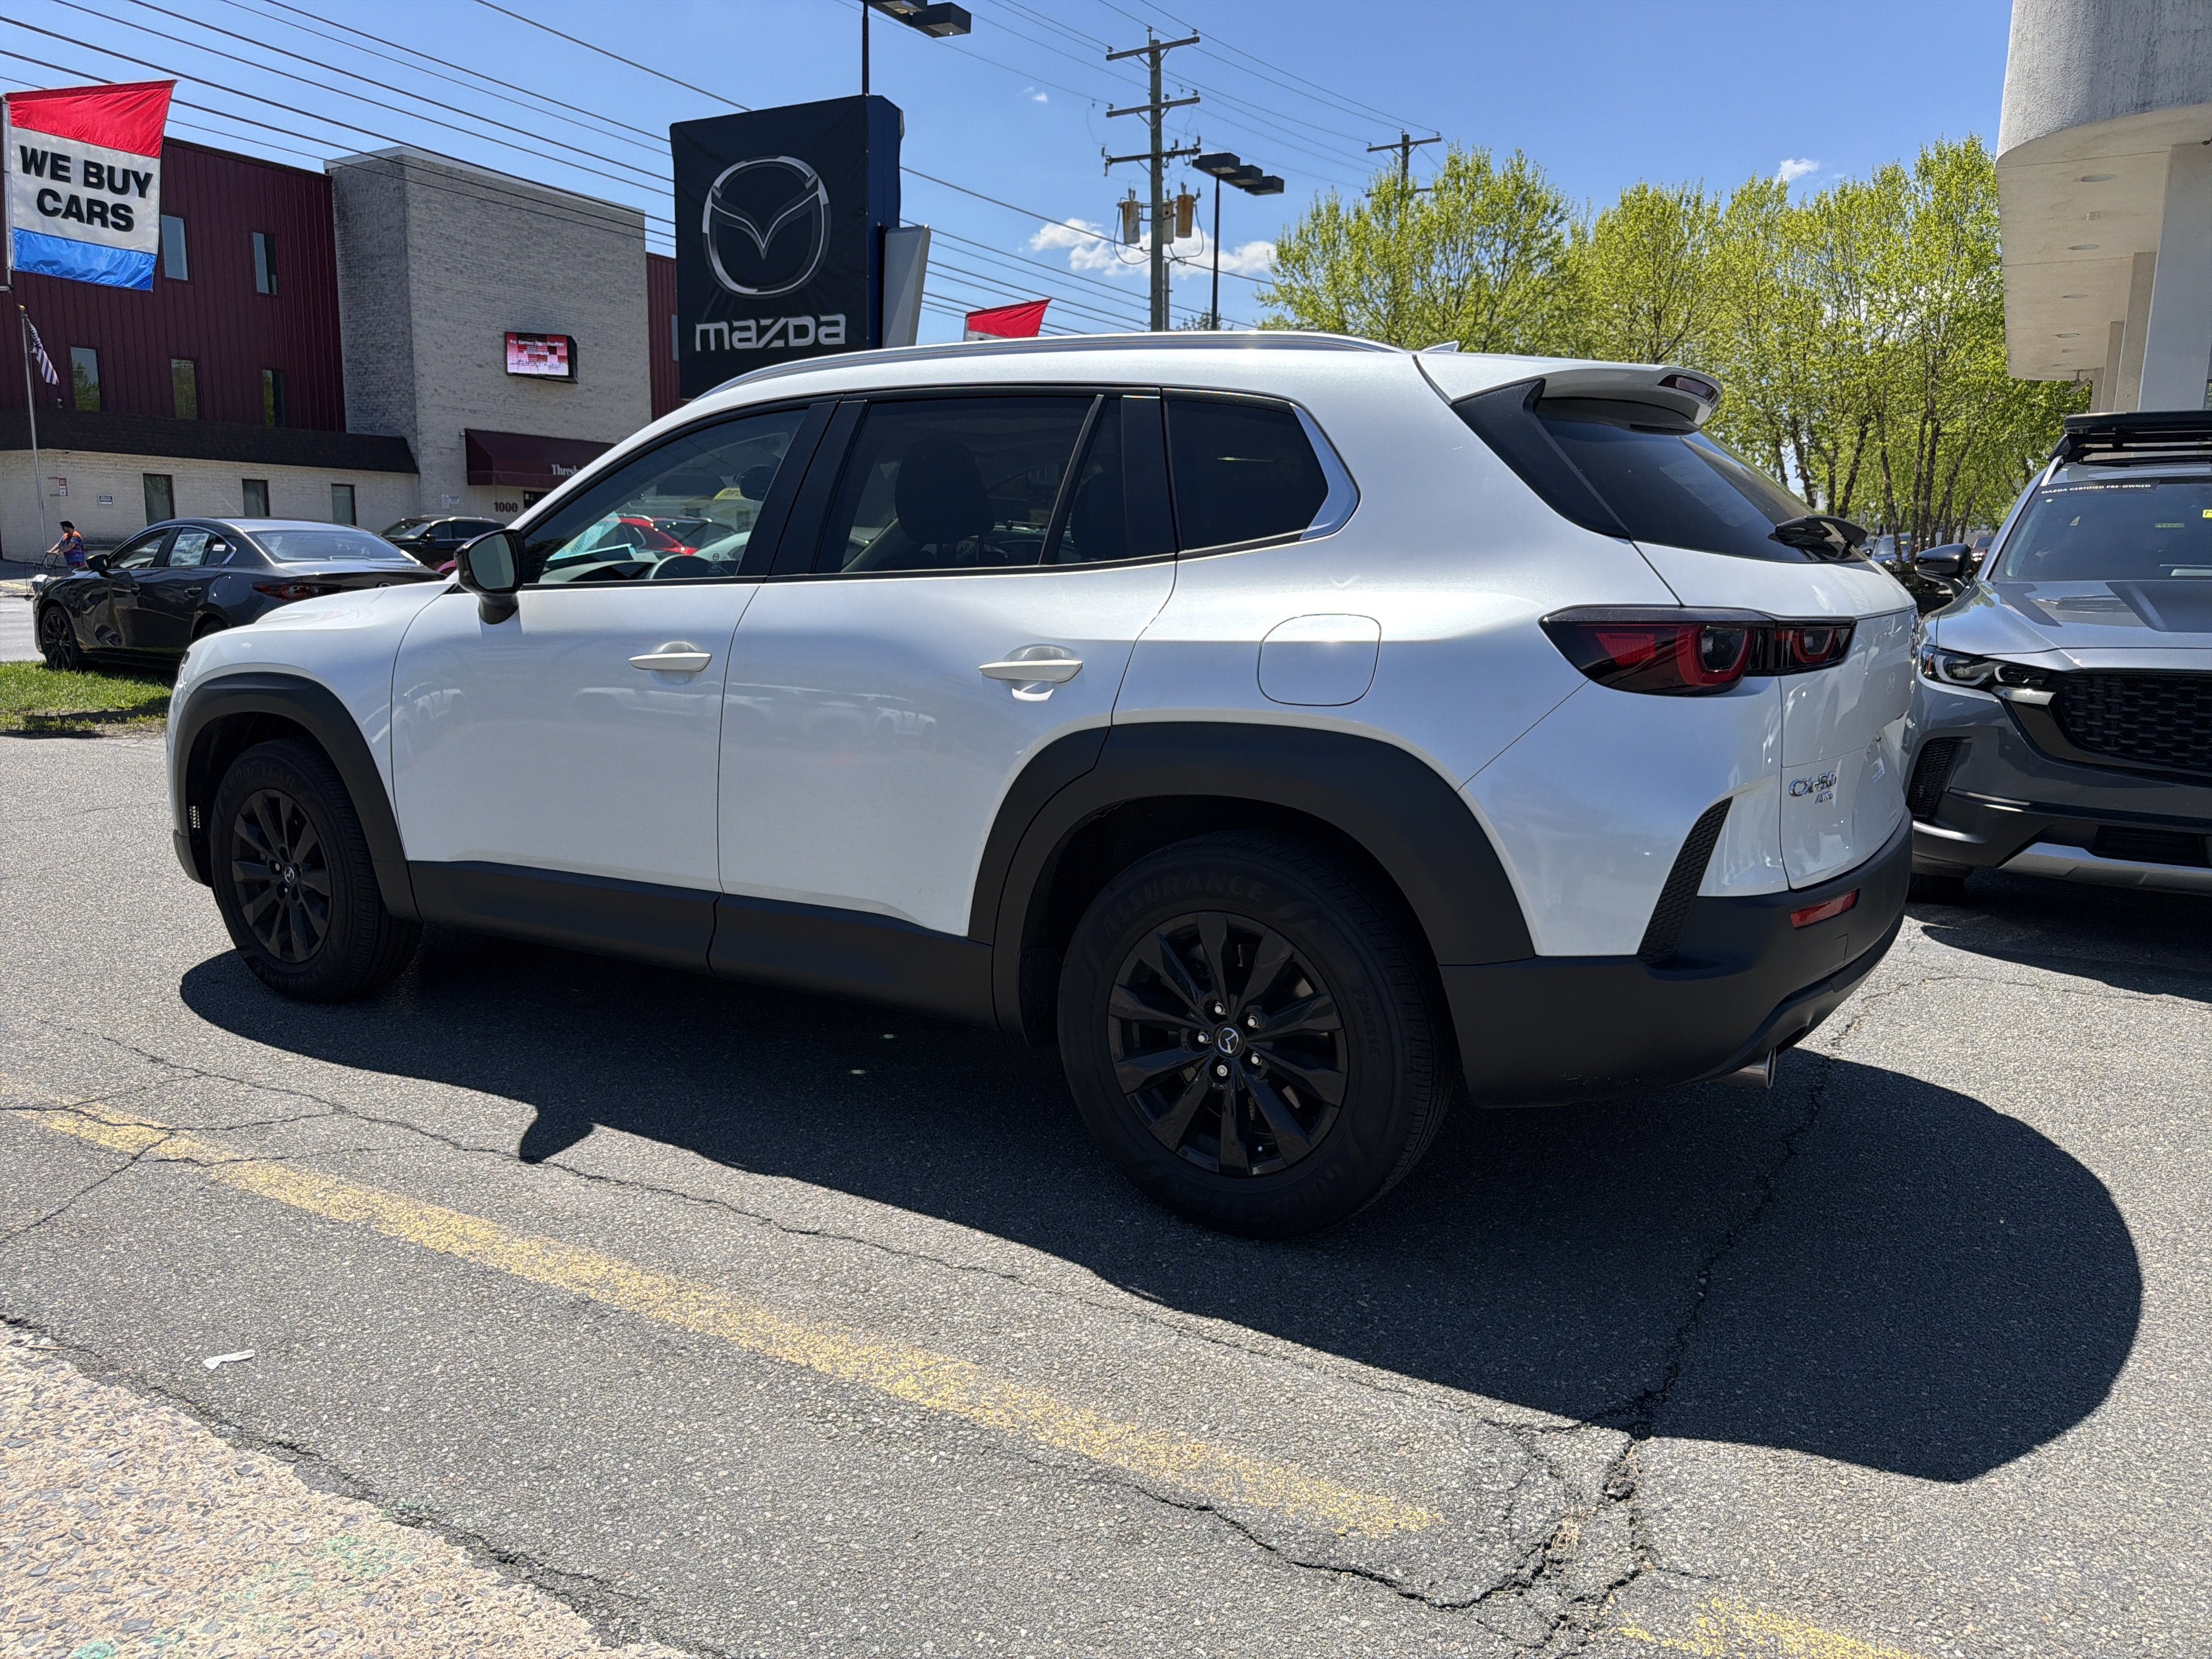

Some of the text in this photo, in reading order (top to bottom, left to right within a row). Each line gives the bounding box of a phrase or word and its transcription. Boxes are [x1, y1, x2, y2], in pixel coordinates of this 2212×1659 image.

[19, 144, 154, 199] WE BUY
[36, 188, 134, 233] CARS
[551, 464, 580, 476] Thresh
[493, 501, 518, 513] 1000
[1788, 770, 1837, 797] CX-50
[1103, 870, 1269, 940] ASSURANCE
